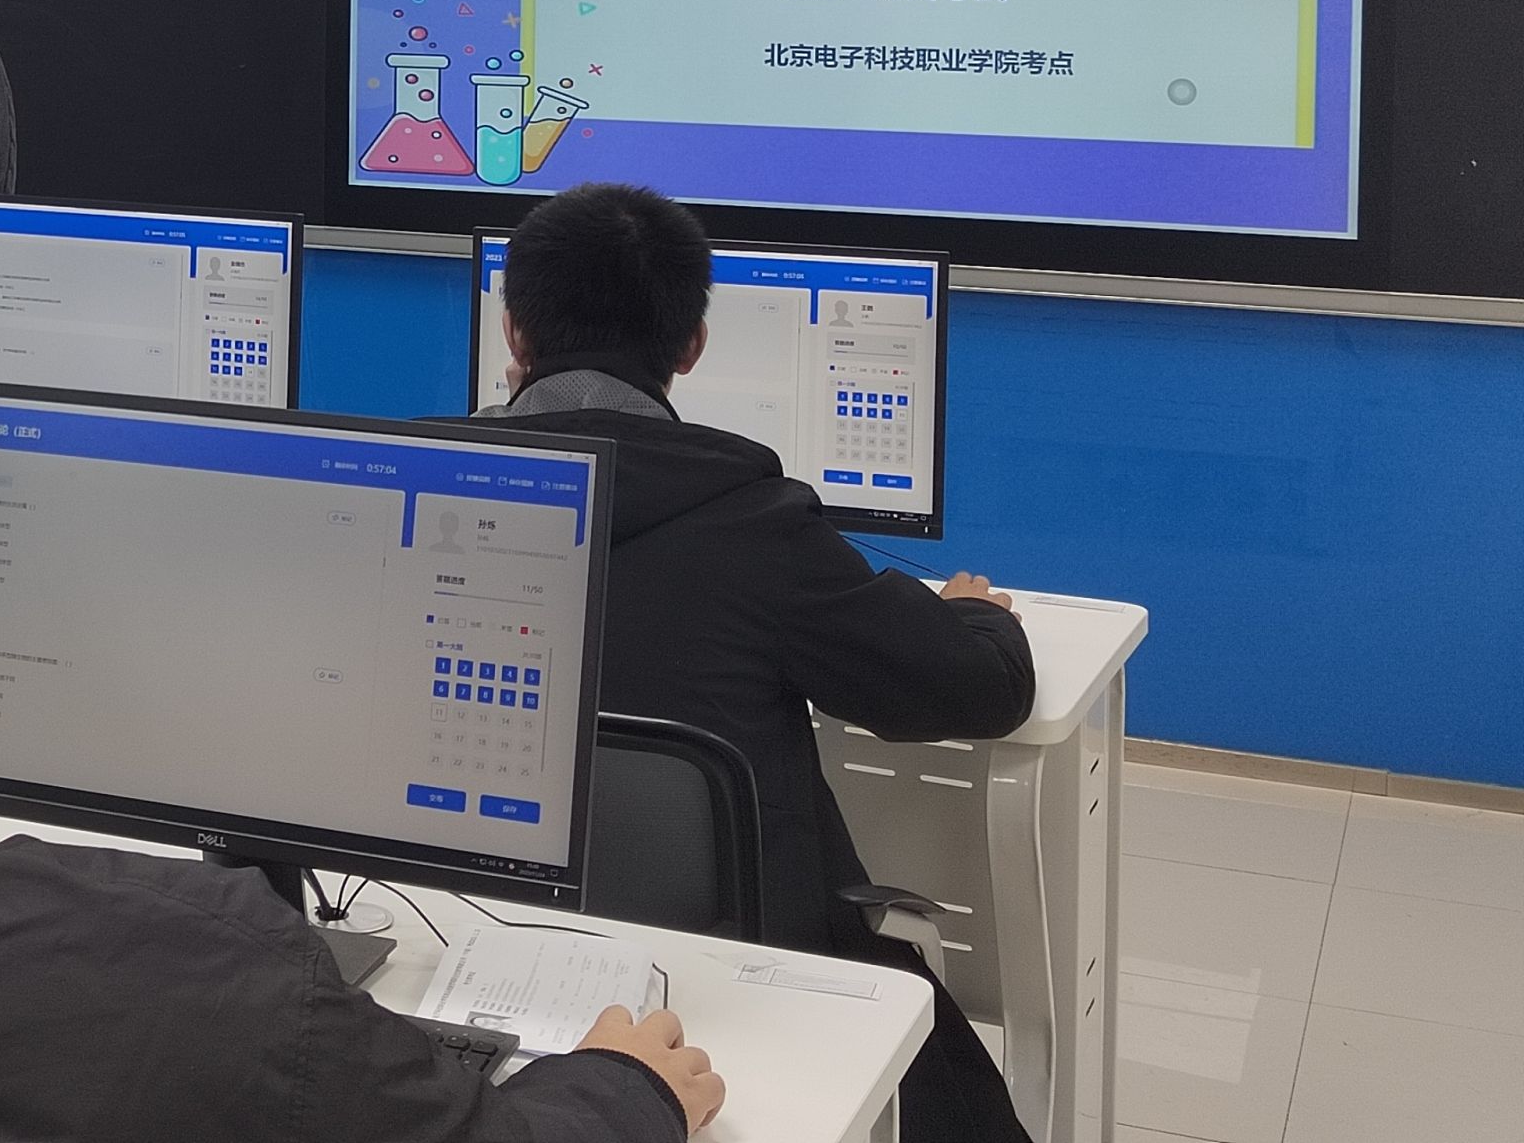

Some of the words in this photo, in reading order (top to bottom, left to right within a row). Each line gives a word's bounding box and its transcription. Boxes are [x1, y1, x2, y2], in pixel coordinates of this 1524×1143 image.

[764, 43, 1075, 76] 北京电子科技职业学院考点
[366, 463, 397, 475] 0:57:04
[522, 585, 543, 593] 11/50
[198, 833, 227, 848] DELL
